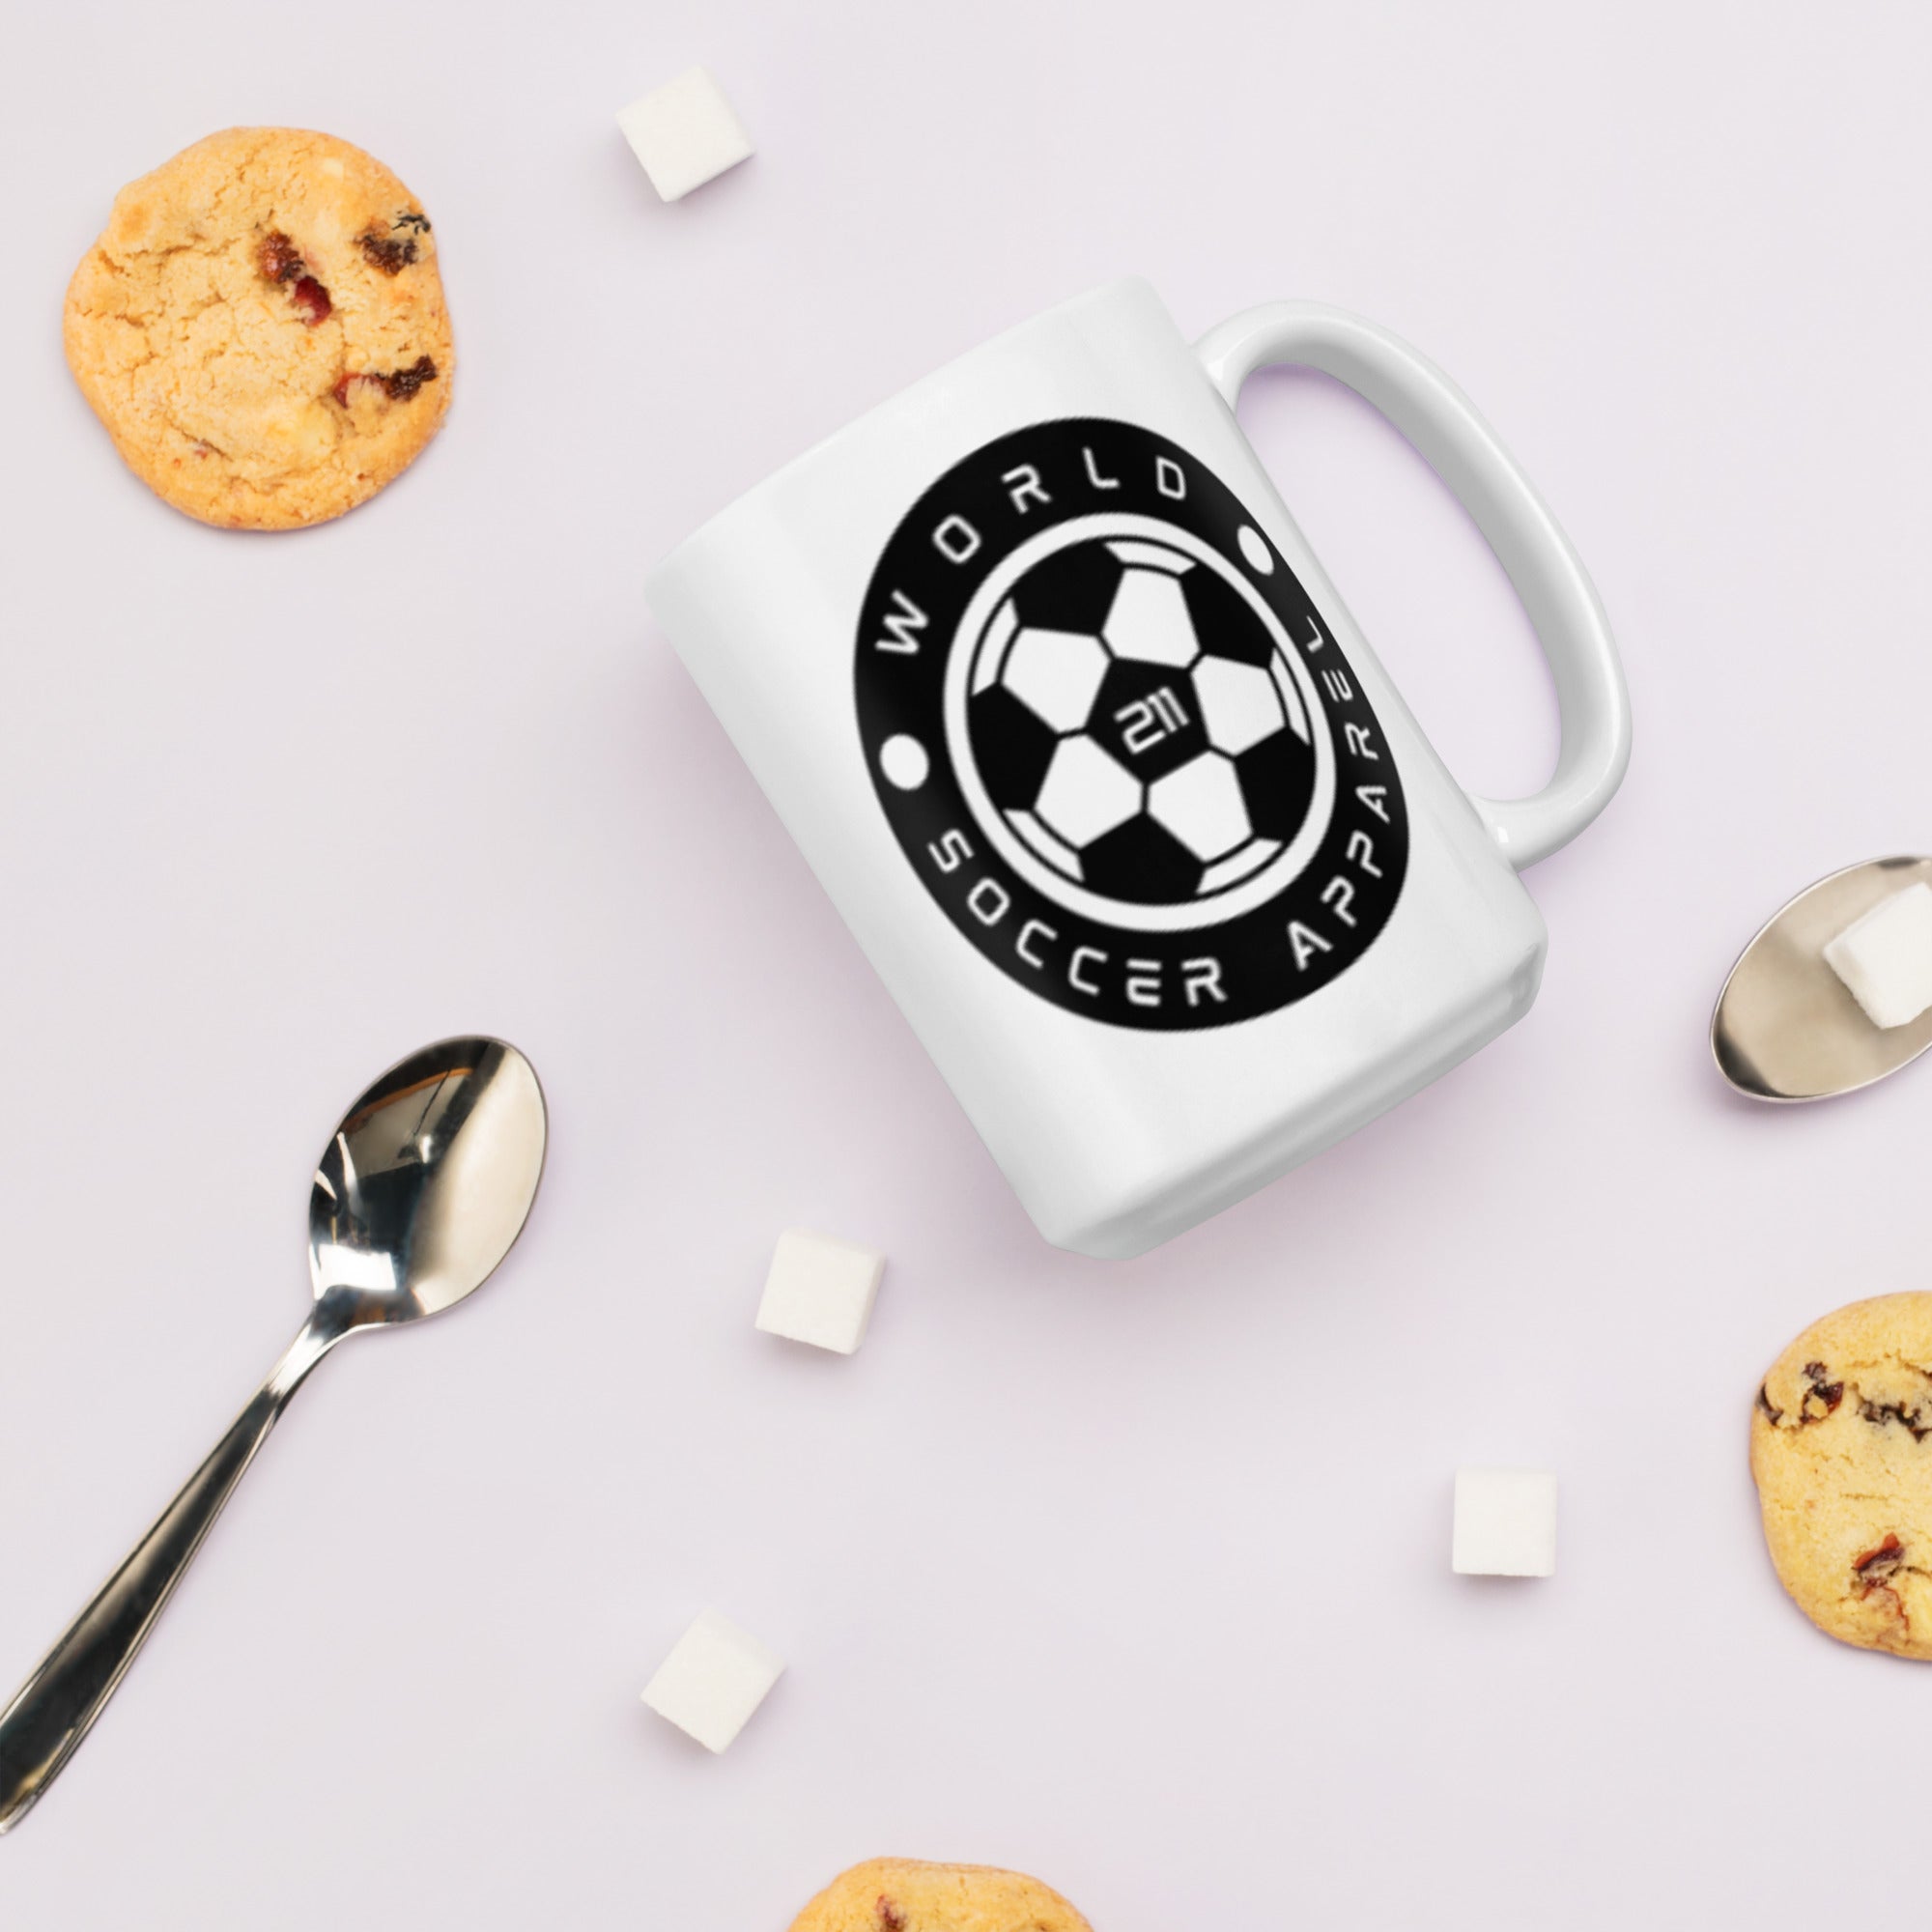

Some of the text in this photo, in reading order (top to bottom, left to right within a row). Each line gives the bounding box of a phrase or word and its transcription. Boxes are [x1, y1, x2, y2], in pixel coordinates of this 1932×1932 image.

[875, 447, 1186, 655] WORLD
[927, 615, 1391, 1007] SOCCER APPAREL
[1114, 686, 1190, 754] 211
